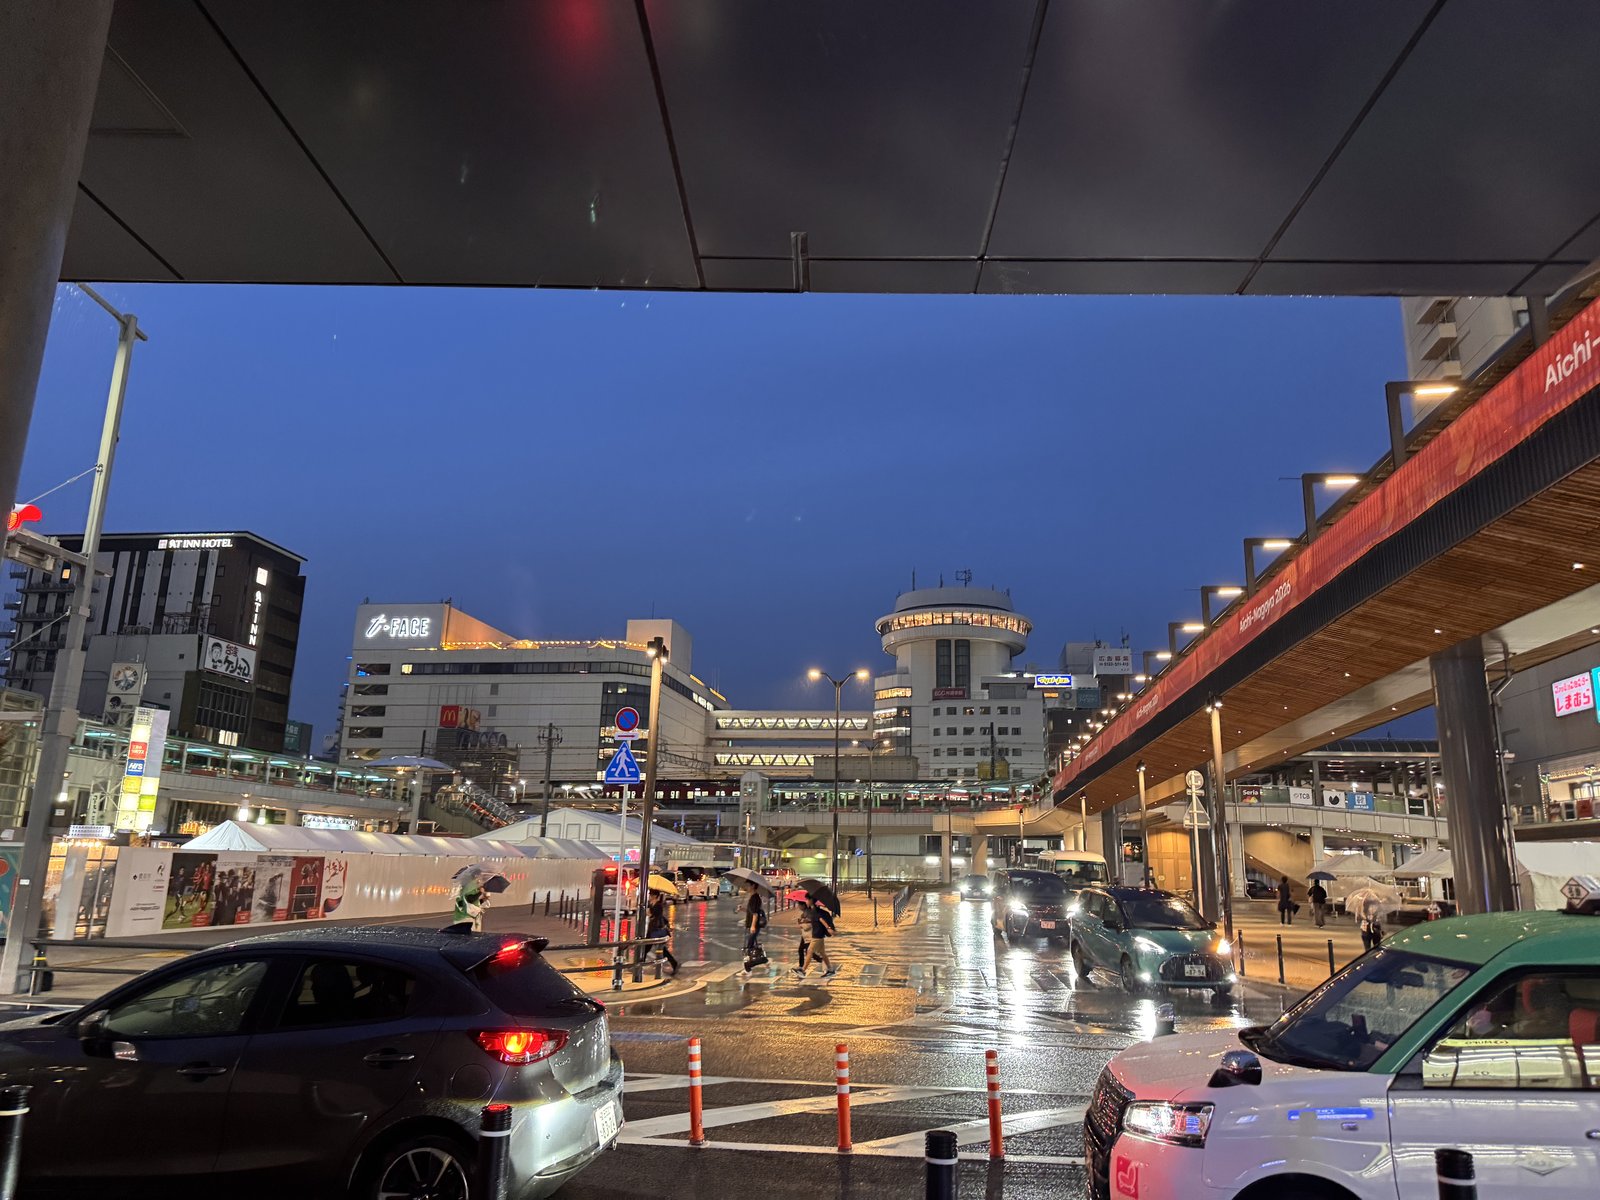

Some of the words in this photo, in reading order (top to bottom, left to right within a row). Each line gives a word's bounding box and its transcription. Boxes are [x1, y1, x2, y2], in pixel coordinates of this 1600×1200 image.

[182, 540, 201, 549] INN
[201, 538, 233, 548] HOTEL
[1274, 579, 1292, 605] 2026
[1556, 688, 1591, 712] しまむら
